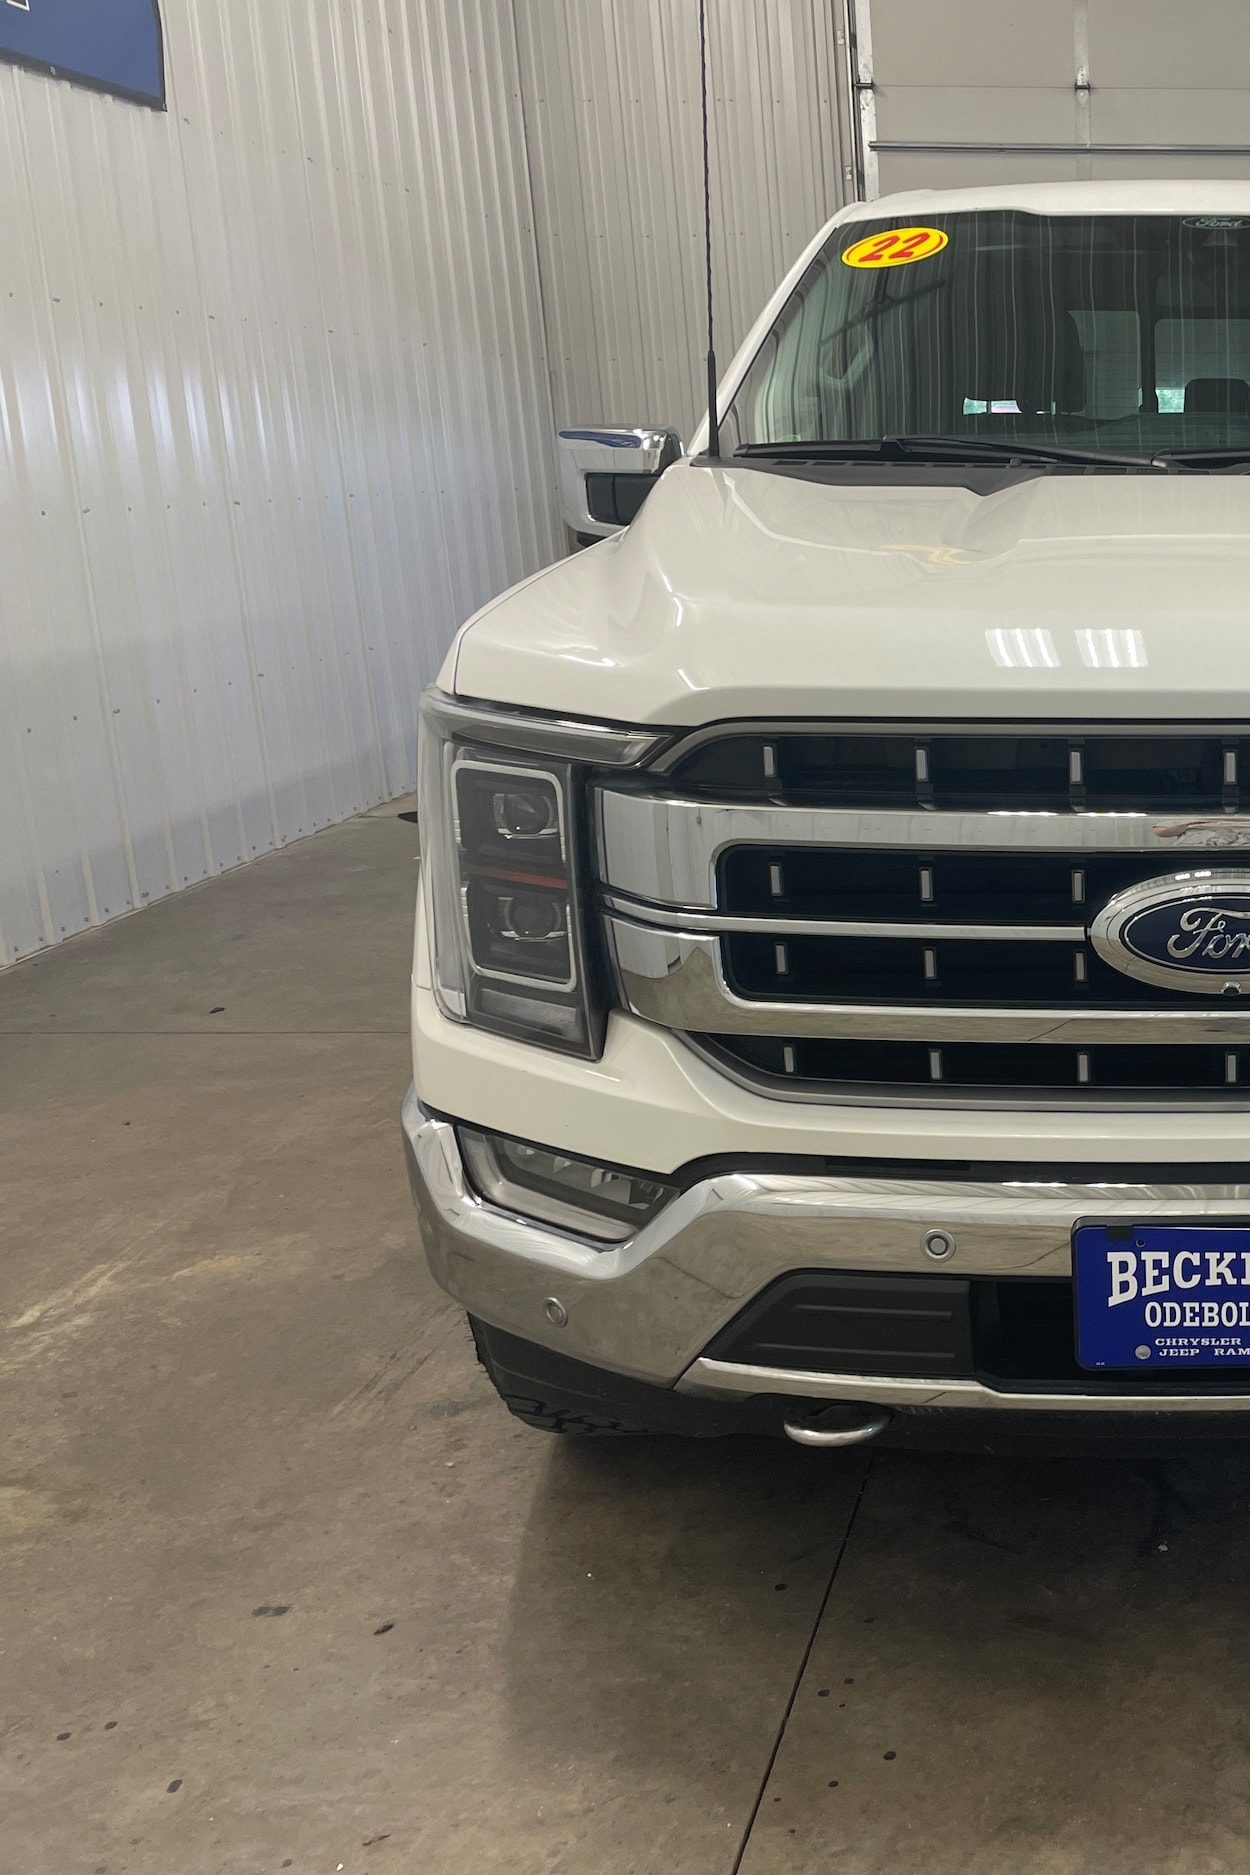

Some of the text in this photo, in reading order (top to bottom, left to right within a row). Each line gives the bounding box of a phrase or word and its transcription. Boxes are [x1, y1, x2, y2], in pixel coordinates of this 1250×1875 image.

[1195, 217, 1243, 228] Ford
[858, 232, 930, 262] 22
[1154, 1337, 1242, 1347] CHRYSLER
[1158, 1348, 1201, 1358] JEEP
